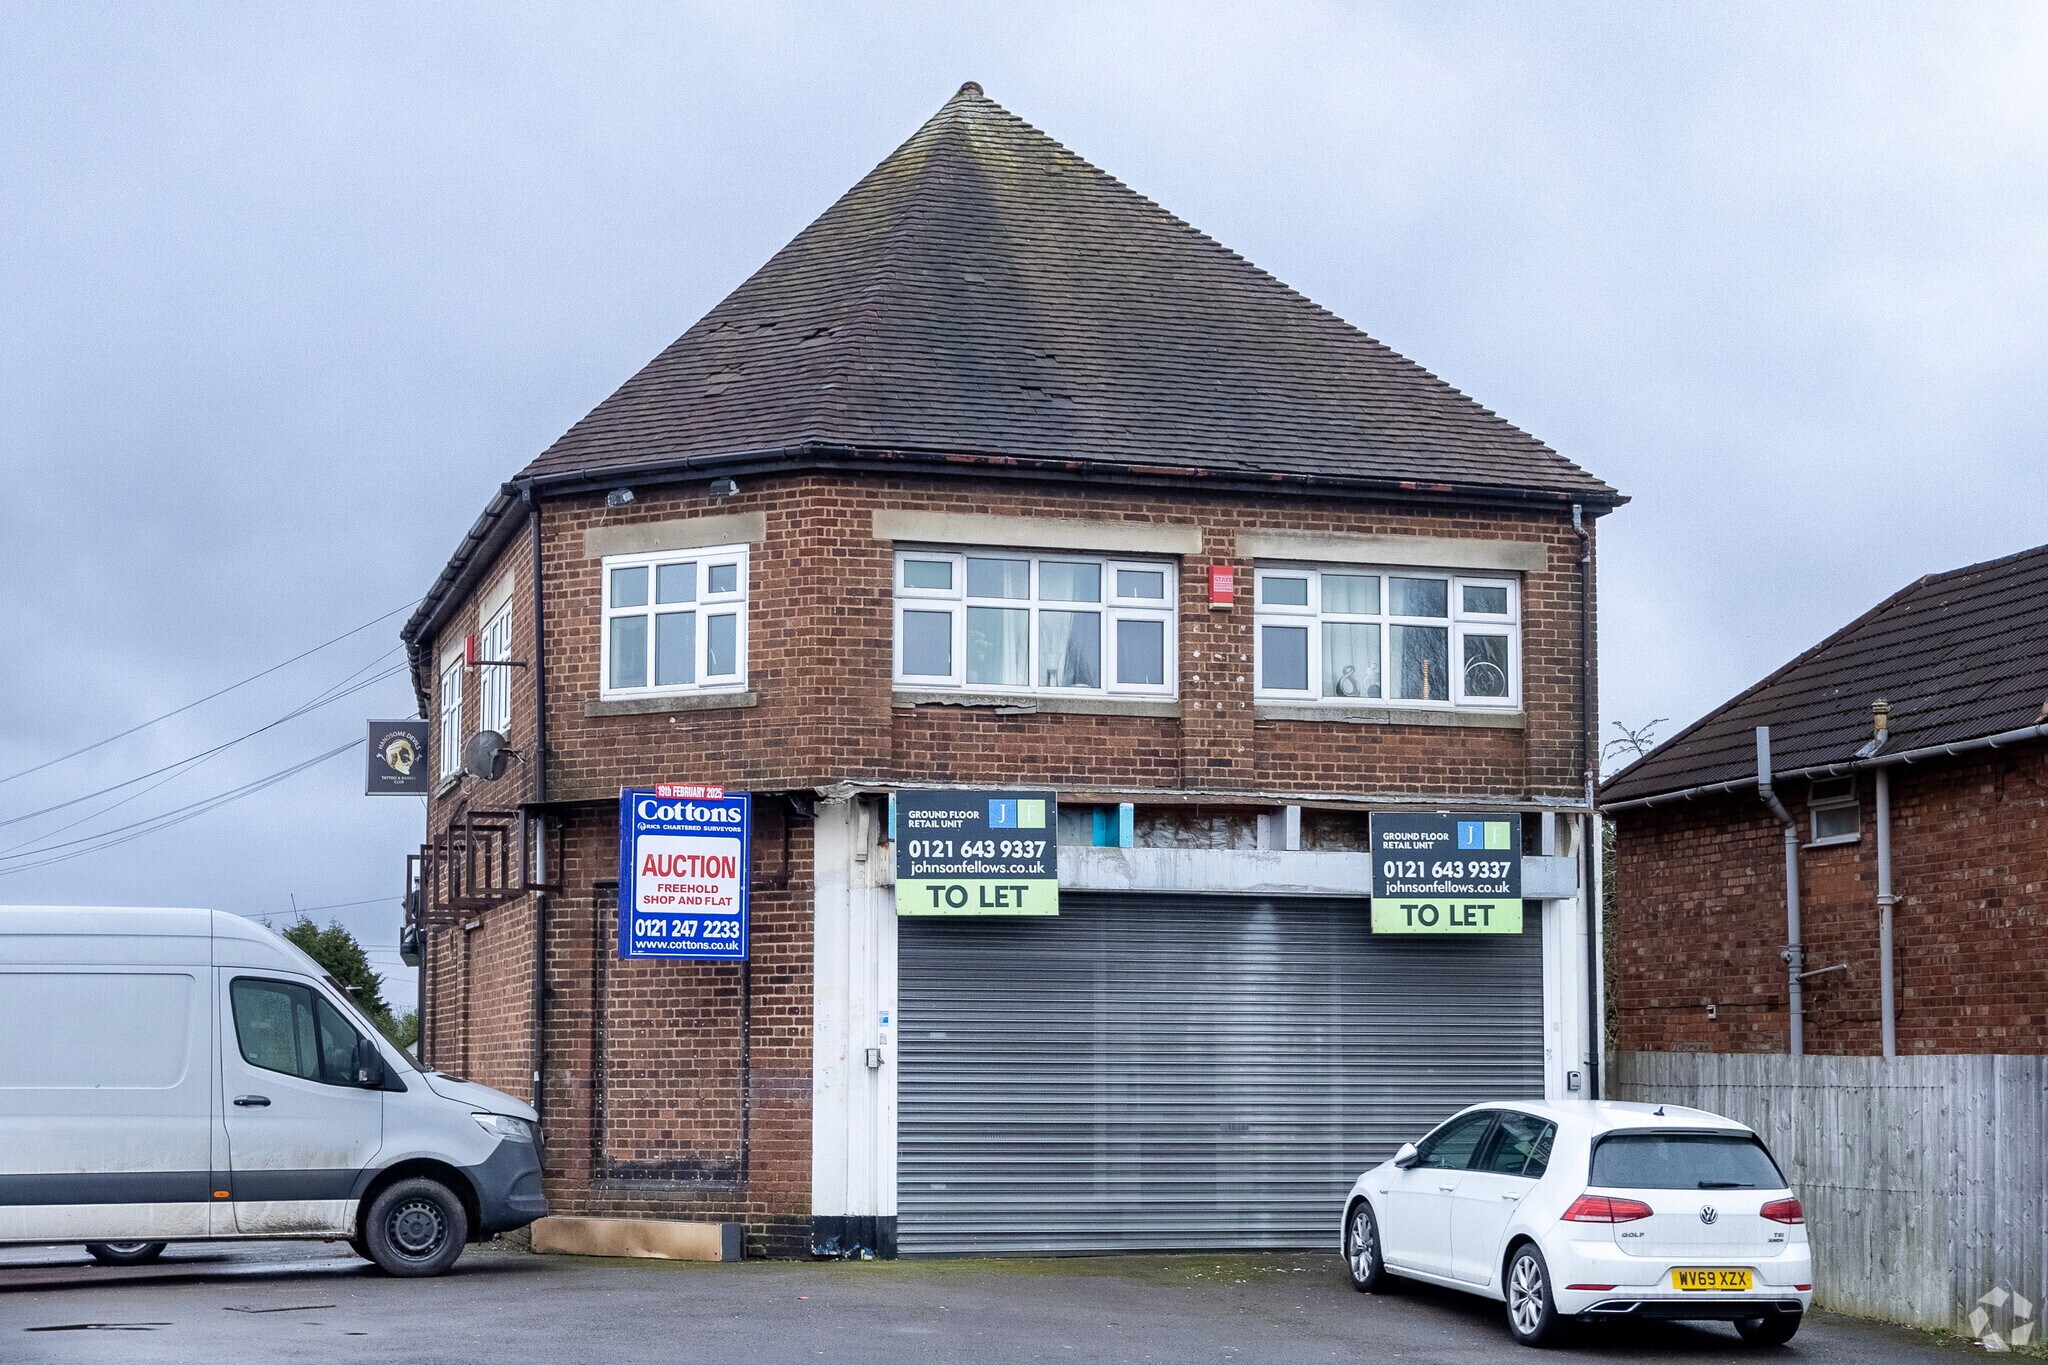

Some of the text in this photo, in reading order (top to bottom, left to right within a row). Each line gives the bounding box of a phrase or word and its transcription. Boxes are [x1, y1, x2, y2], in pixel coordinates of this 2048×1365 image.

[378, 731, 422, 750] HANDSOME DEVILS
[658, 786, 722, 799] 19th FEBRUARY 2025
[637, 800, 742, 823] Cottons
[908, 810, 980, 819] GROUND FLOOR
[998, 804, 1006, 824] J
[908, 820, 964, 828] RETAIL UNIT
[1382, 832, 1450, 840] GROUND FLOOR
[1466, 826, 1474, 845] J
[908, 840, 1046, 858] 0121 643 9337
[1382, 842, 1434, 850] RETAIL UNIT
[642, 854, 736, 879] AUCTION
[910, 860, 1046, 876] johnsonfellows.co.uk
[1384, 860, 1512, 878] 0121 643 9337
[657, 884, 718, 894] FREEHOLD
[926, 884, 1029, 908] TO LET
[1386, 880, 1510, 896] johnsonfellows.co.uk
[643, 895, 732, 906] SHOP AND FLAT
[1400, 904, 1495, 926] TO LET
[635, 918, 740, 938] 0121 247 2233
[635, 940, 738, 950] www.cottons.co.uk
[1680, 1272, 1746, 1286] WV69 XZX
